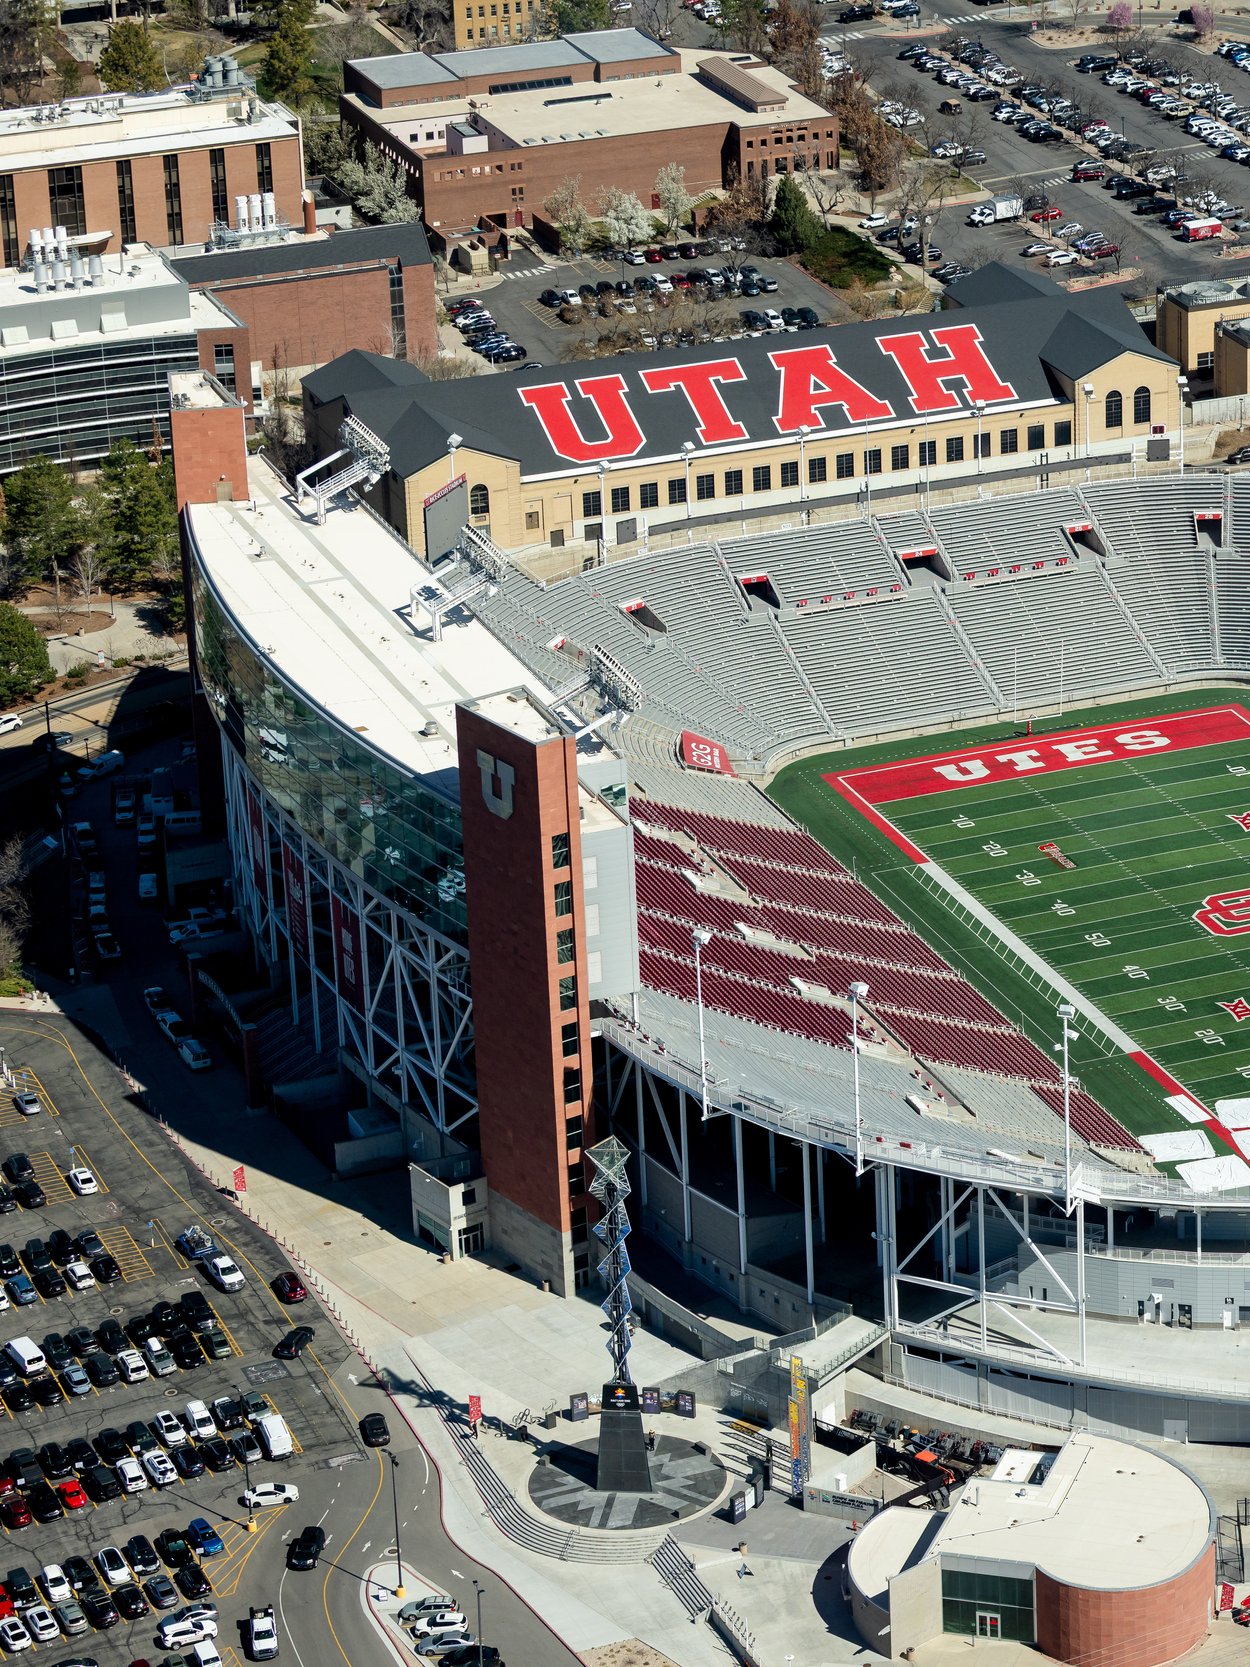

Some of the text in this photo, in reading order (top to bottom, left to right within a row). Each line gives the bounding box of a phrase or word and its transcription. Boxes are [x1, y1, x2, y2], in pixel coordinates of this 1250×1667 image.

[516, 323, 1019, 464] UTAH
[691, 743, 712, 766] G2G
[932, 730, 1172, 781] UTES
[476, 748, 515, 820] U
[951, 815, 975, 829] 10
[982, 843, 1008, 857] 20
[1016, 872, 1042, 886] 30
[1051, 902, 1076, 916] 40
[1084, 932, 1111, 947] 50
[1122, 965, 1147, 979] 40
[1157, 996, 1184, 1011] 30
[1194, 1028, 1222, 1044] 20
